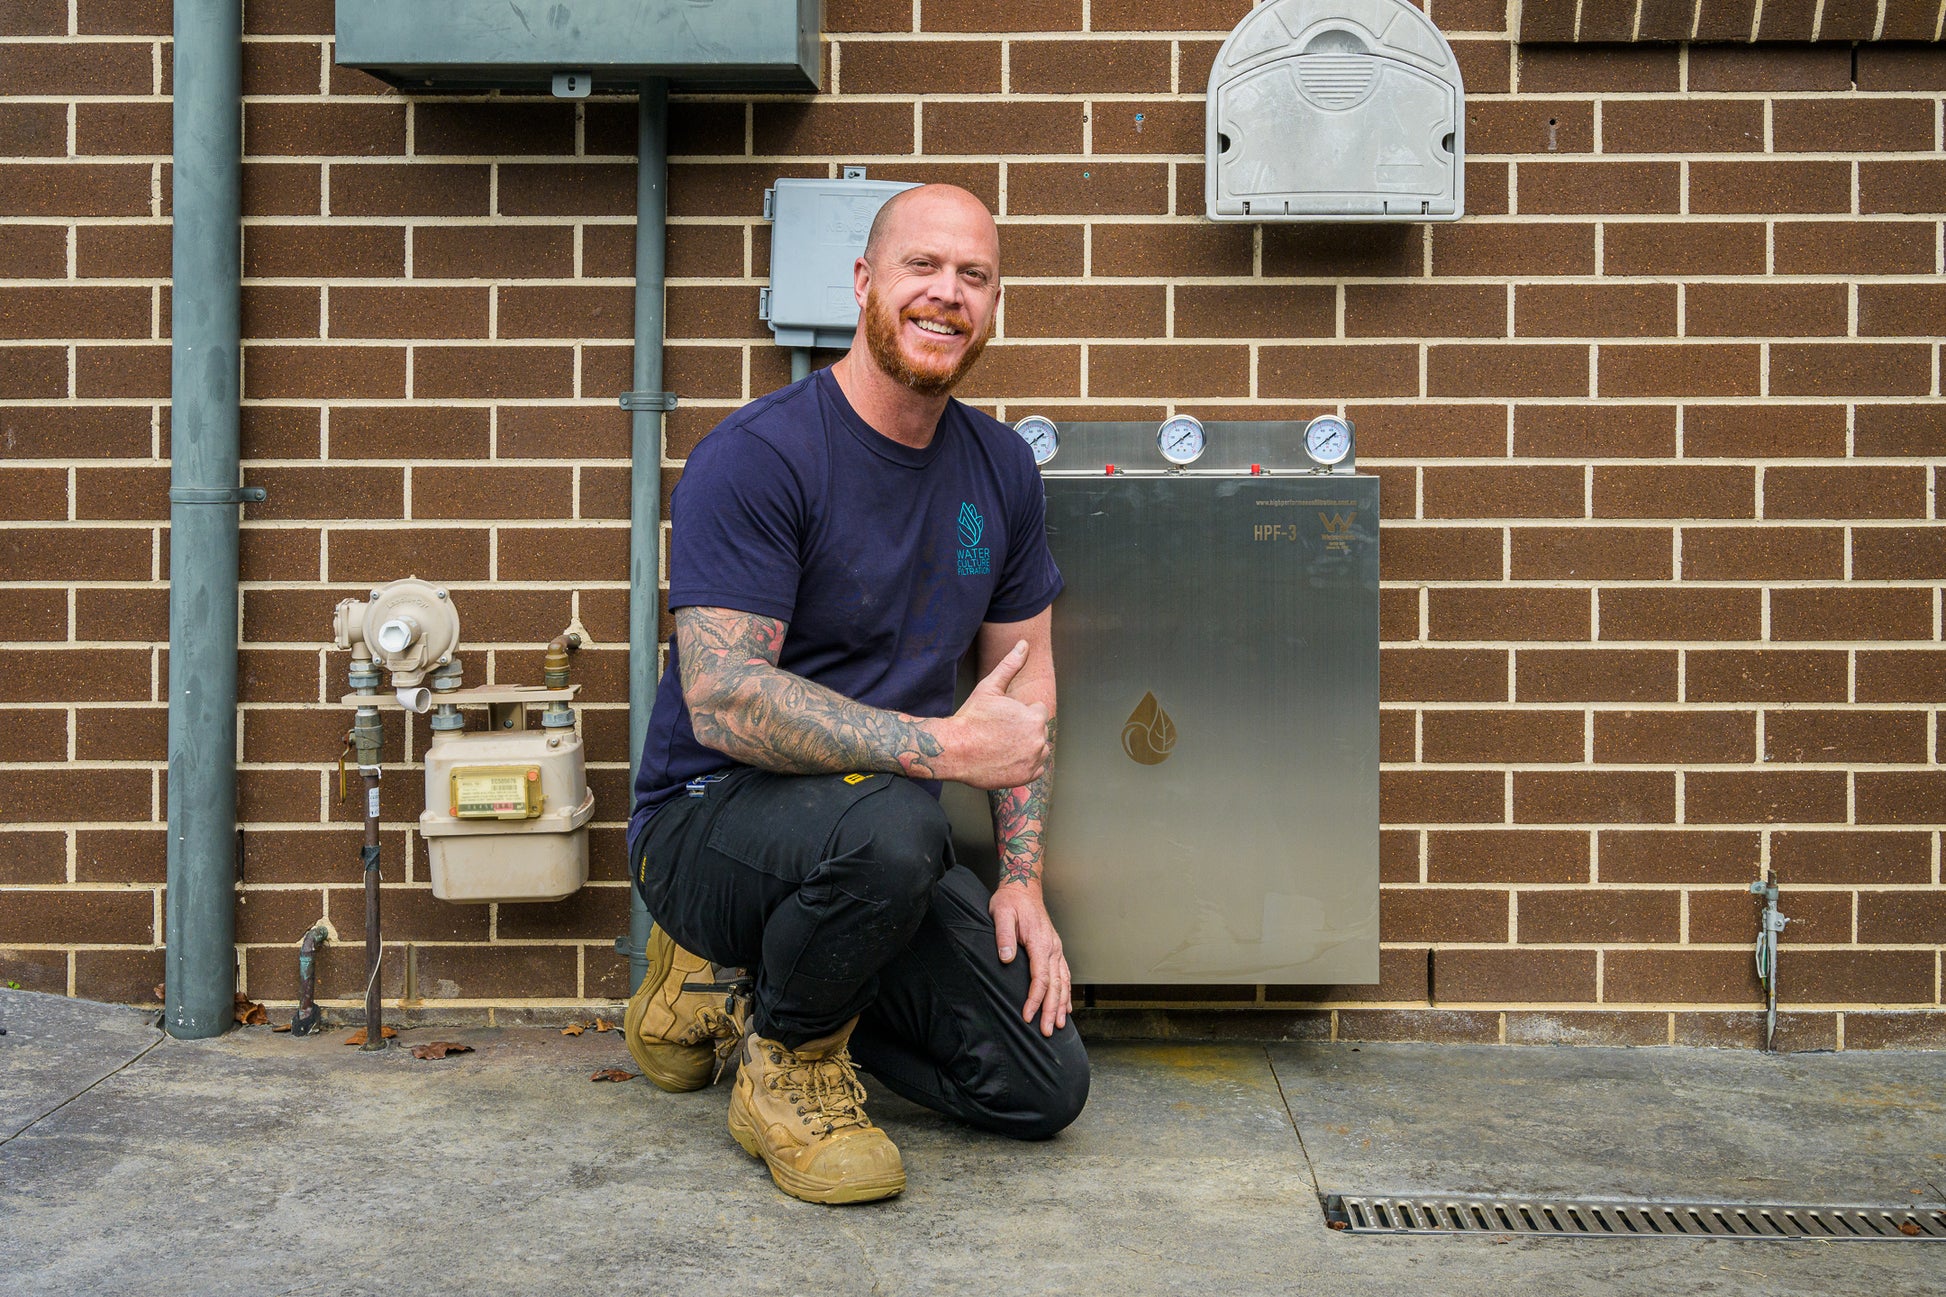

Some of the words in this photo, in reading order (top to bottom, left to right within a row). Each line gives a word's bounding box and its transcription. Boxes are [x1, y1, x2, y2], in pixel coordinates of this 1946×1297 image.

[1254, 524, 1297, 541] HPF-3
[957, 547, 990, 559] WATER
[957, 558, 990, 568] CULTURE
[957, 566, 991, 576] FILTRATION
